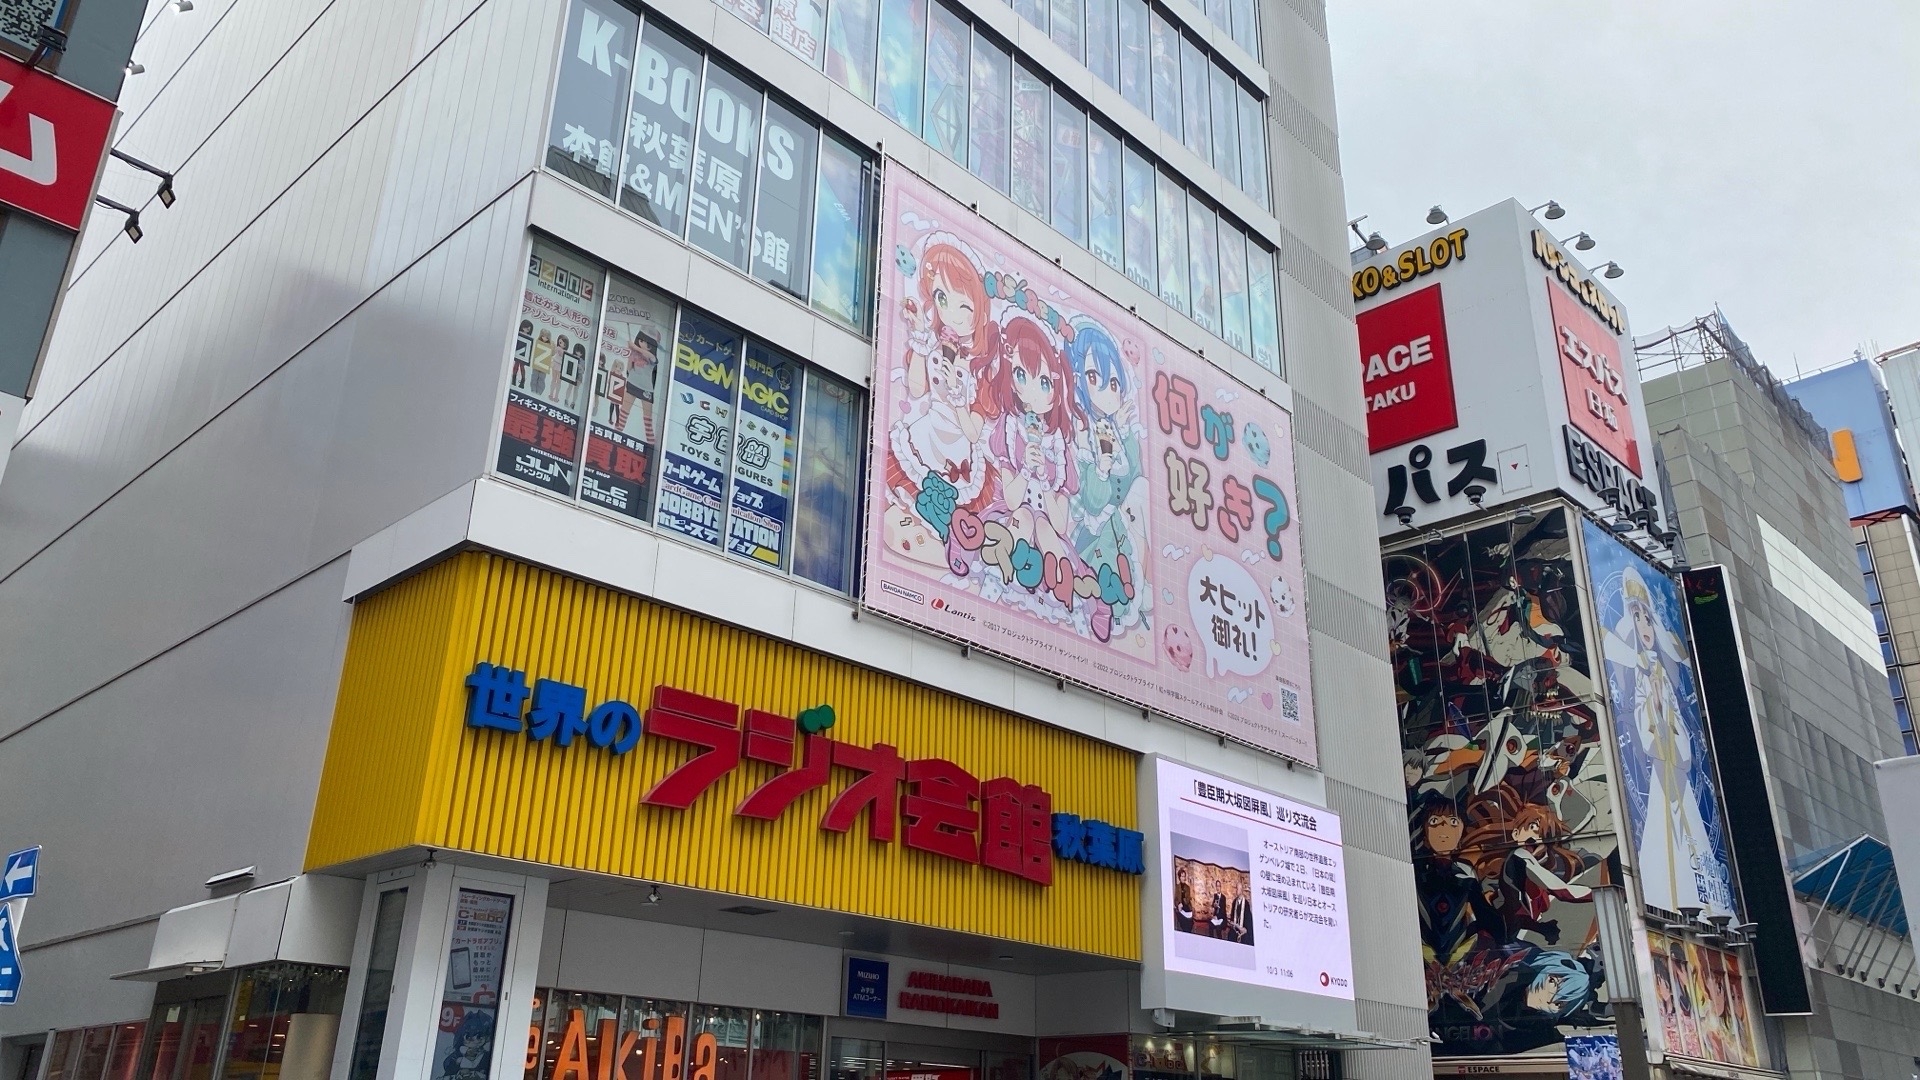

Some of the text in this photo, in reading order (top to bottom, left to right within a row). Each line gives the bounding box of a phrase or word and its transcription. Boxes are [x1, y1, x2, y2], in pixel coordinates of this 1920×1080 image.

[577, 8, 794, 181] K-BOOKS
[629, 110, 743, 204] 秋葉原
[606, 304, 651, 321] abelshop
[608, 293, 636, 305] zone
[1362, 334, 1434, 383] ACE
[1152, 370, 1235, 461] 何が
[680, 442, 709, 462] TOYS
[735, 463, 774, 487] IGURES
[1383, 438, 1498, 516] パス
[1561, 424, 1664, 540] ESPACE
[663, 480, 702, 502] ardGame
[944, 604, 976, 622] Lantis
[1200, 575, 1265, 629] 大ヒット
[465, 661, 1146, 888] 世界の ラジオ会館 秋葉原
[857, 970, 880, 981] MIZUHO
[907, 971, 994, 998] AKIHABARA
[1330, 976, 1348, 989] KYODO
[440, 1007, 461, 1028] 9F
[1467, 1065, 1500, 1074] ESPACE
